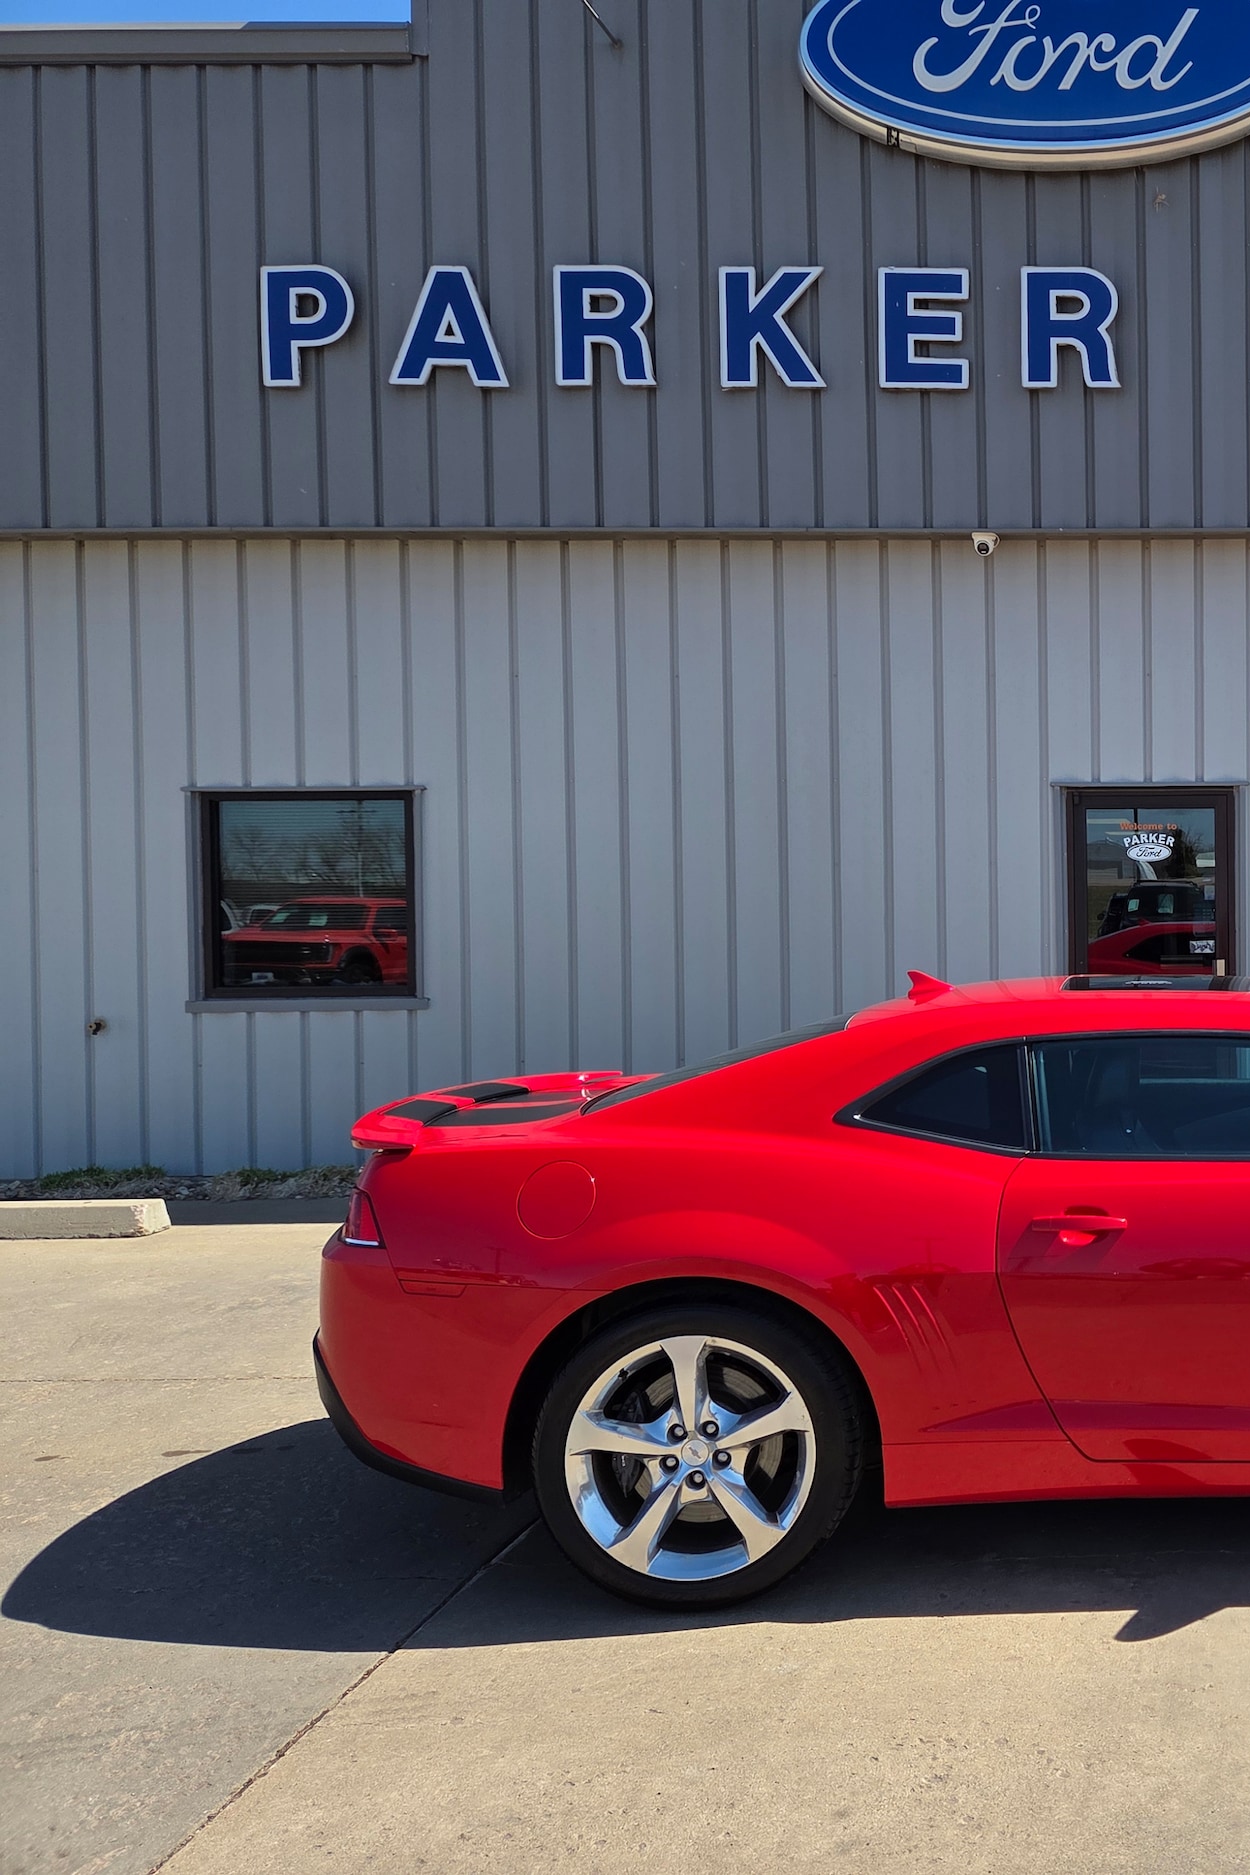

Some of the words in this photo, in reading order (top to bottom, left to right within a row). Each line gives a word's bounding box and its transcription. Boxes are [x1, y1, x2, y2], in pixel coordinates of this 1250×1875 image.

[912, 0, 1200, 92] Ford
[260, 264, 1121, 389] PARKER
[1120, 822, 1163, 830] Welcome
[1123, 832, 1175, 847] PARKER
[1136, 846, 1162, 857] Ford
